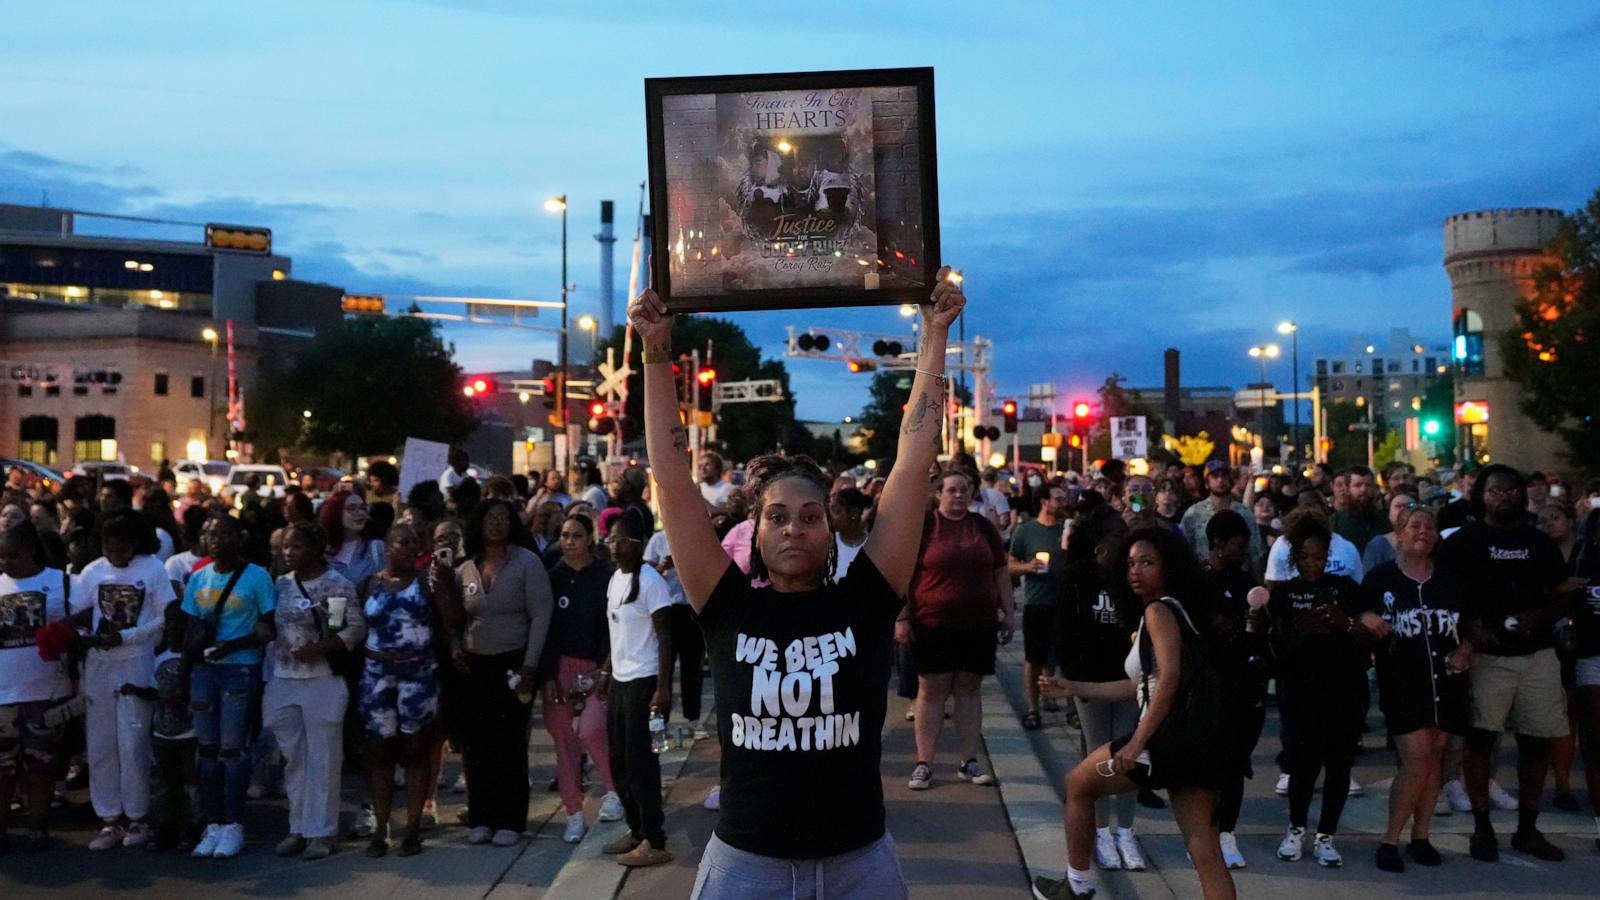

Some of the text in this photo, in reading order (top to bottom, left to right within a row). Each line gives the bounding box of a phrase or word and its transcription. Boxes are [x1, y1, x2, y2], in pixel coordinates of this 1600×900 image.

[744, 90, 856, 110] Forever In Our
[756, 110, 846, 129] HEARTS
[769, 213, 836, 240] Justice
[774, 257, 833, 272] Corey Ruiz
[735, 626, 857, 673] WE BEEN
[751, 660, 839, 717] NOT
[731, 710, 860, 752] BREATHIN
